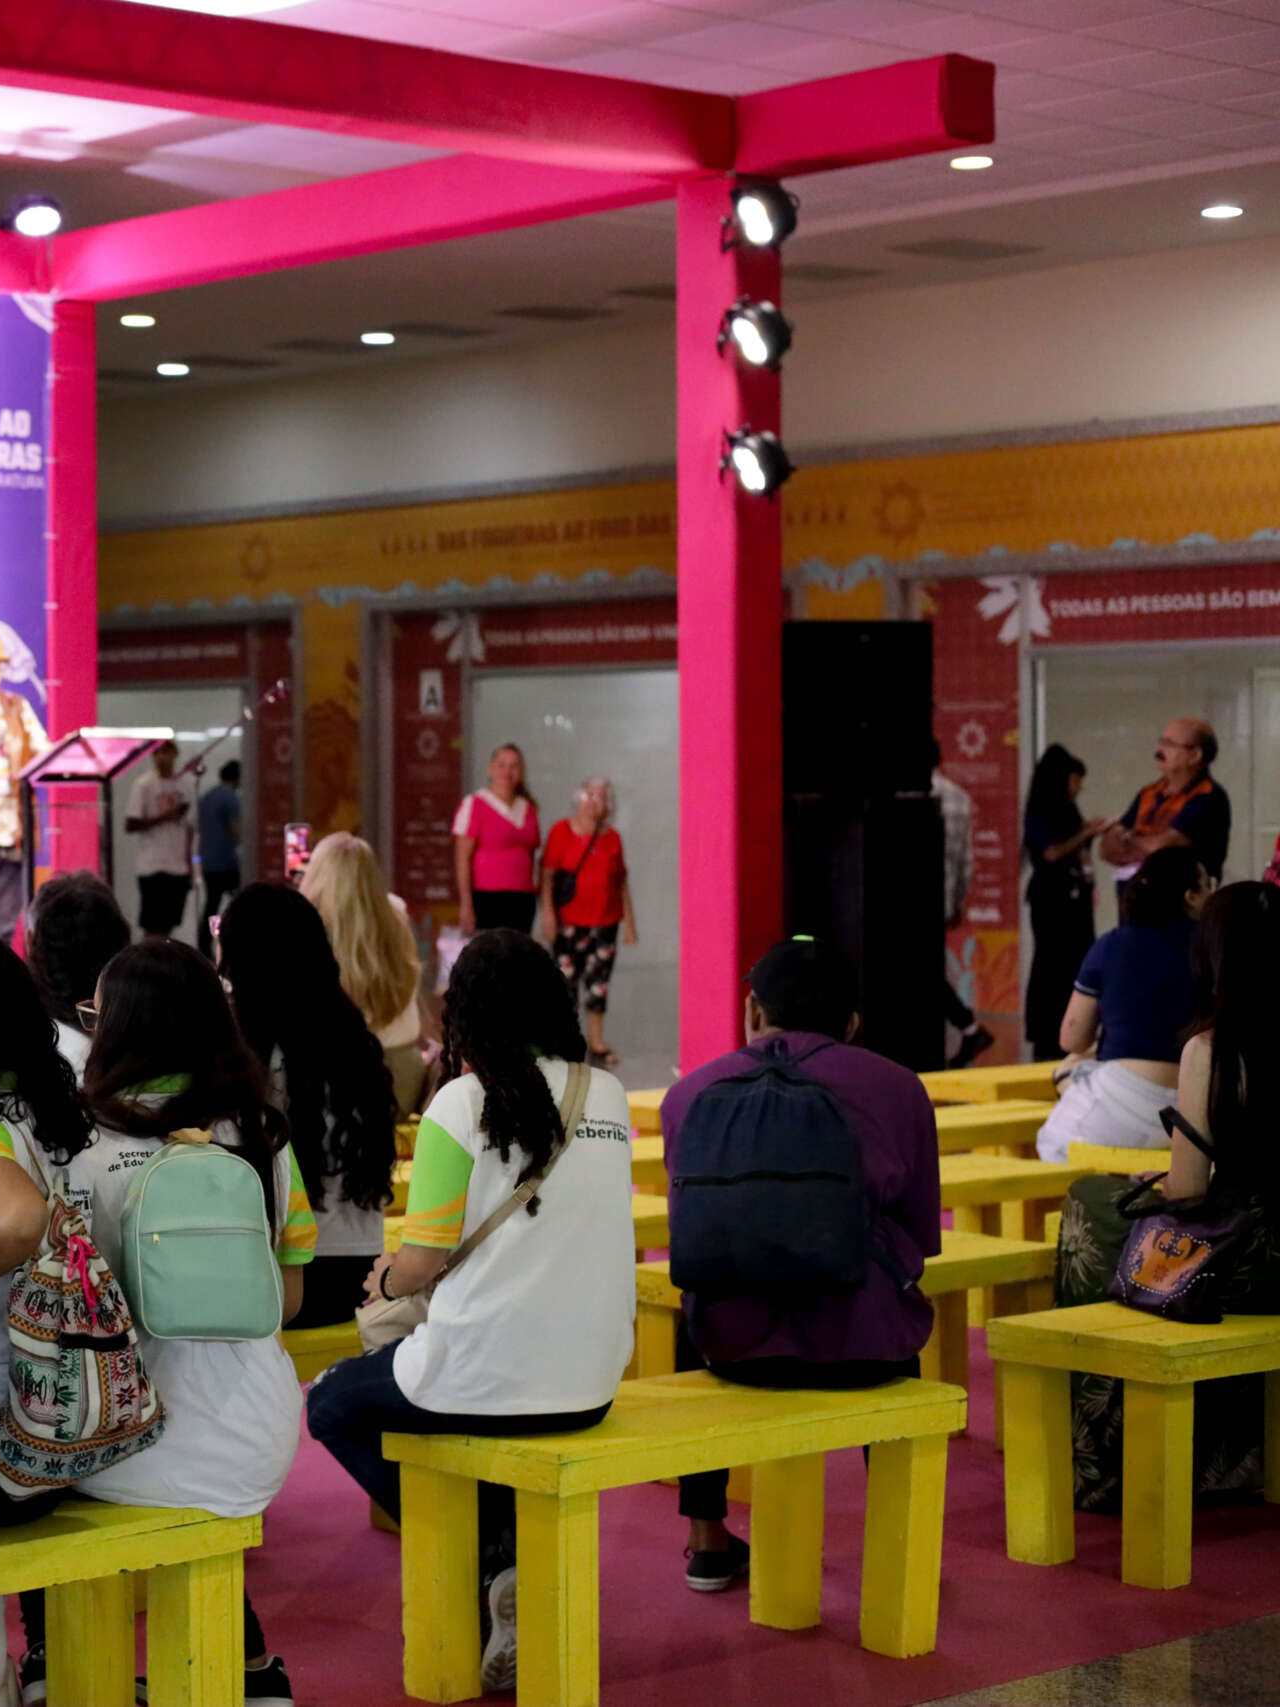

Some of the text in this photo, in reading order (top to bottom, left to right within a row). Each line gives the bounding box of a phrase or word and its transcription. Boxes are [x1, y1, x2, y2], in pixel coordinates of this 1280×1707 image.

[1106, 595, 1128, 616] AS
[1130, 591, 1206, 615] PESSOAS
[1208, 586, 1244, 609] SÃO
[108, 1164, 121, 1172] de
